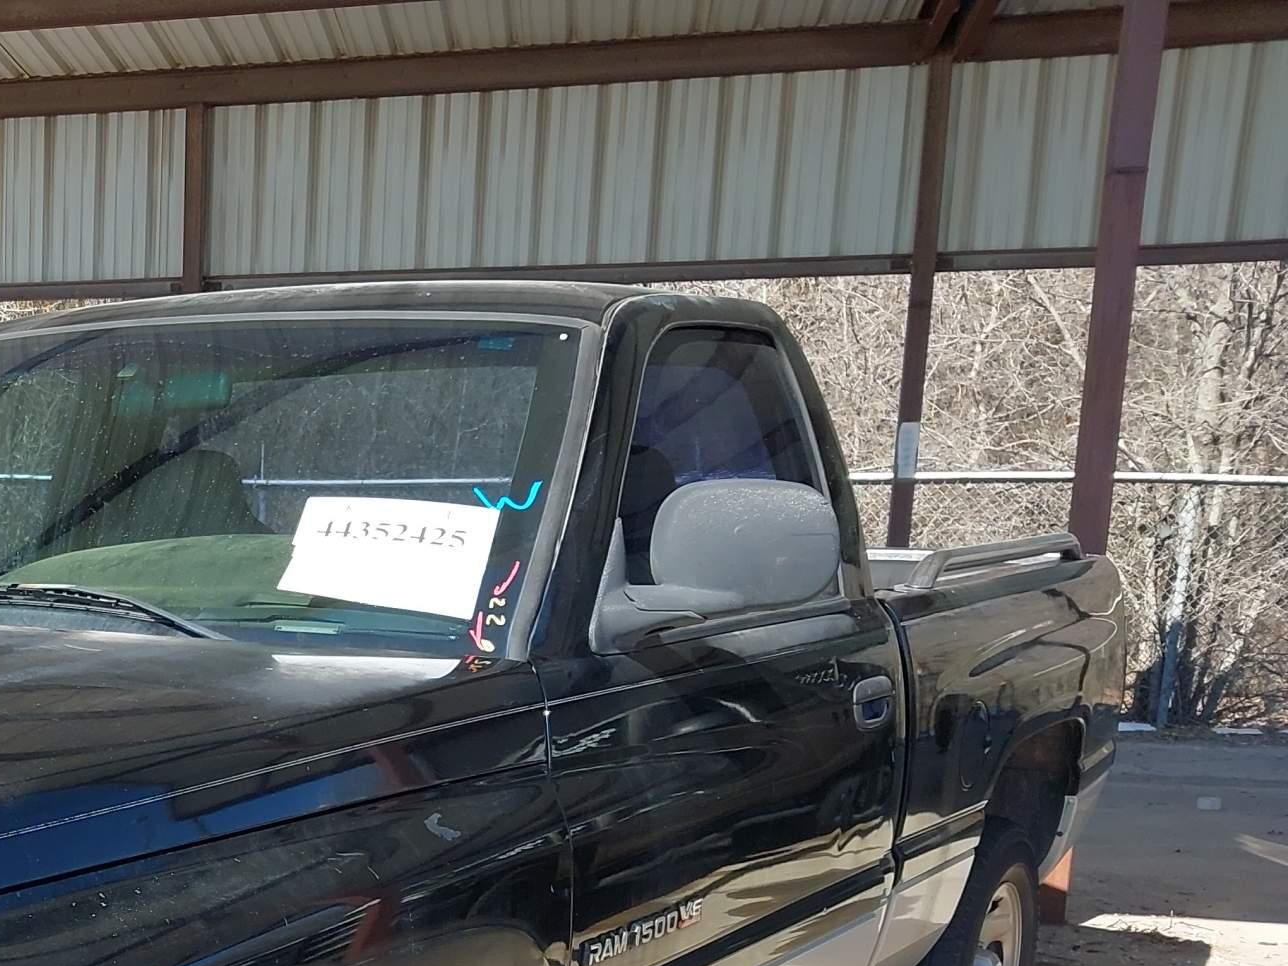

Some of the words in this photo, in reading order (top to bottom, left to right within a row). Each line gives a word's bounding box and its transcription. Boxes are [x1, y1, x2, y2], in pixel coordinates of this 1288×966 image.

[316, 520, 468, 548] 44352425
[588, 931, 628, 966] RAM
[633, 910, 679, 947] 1500
